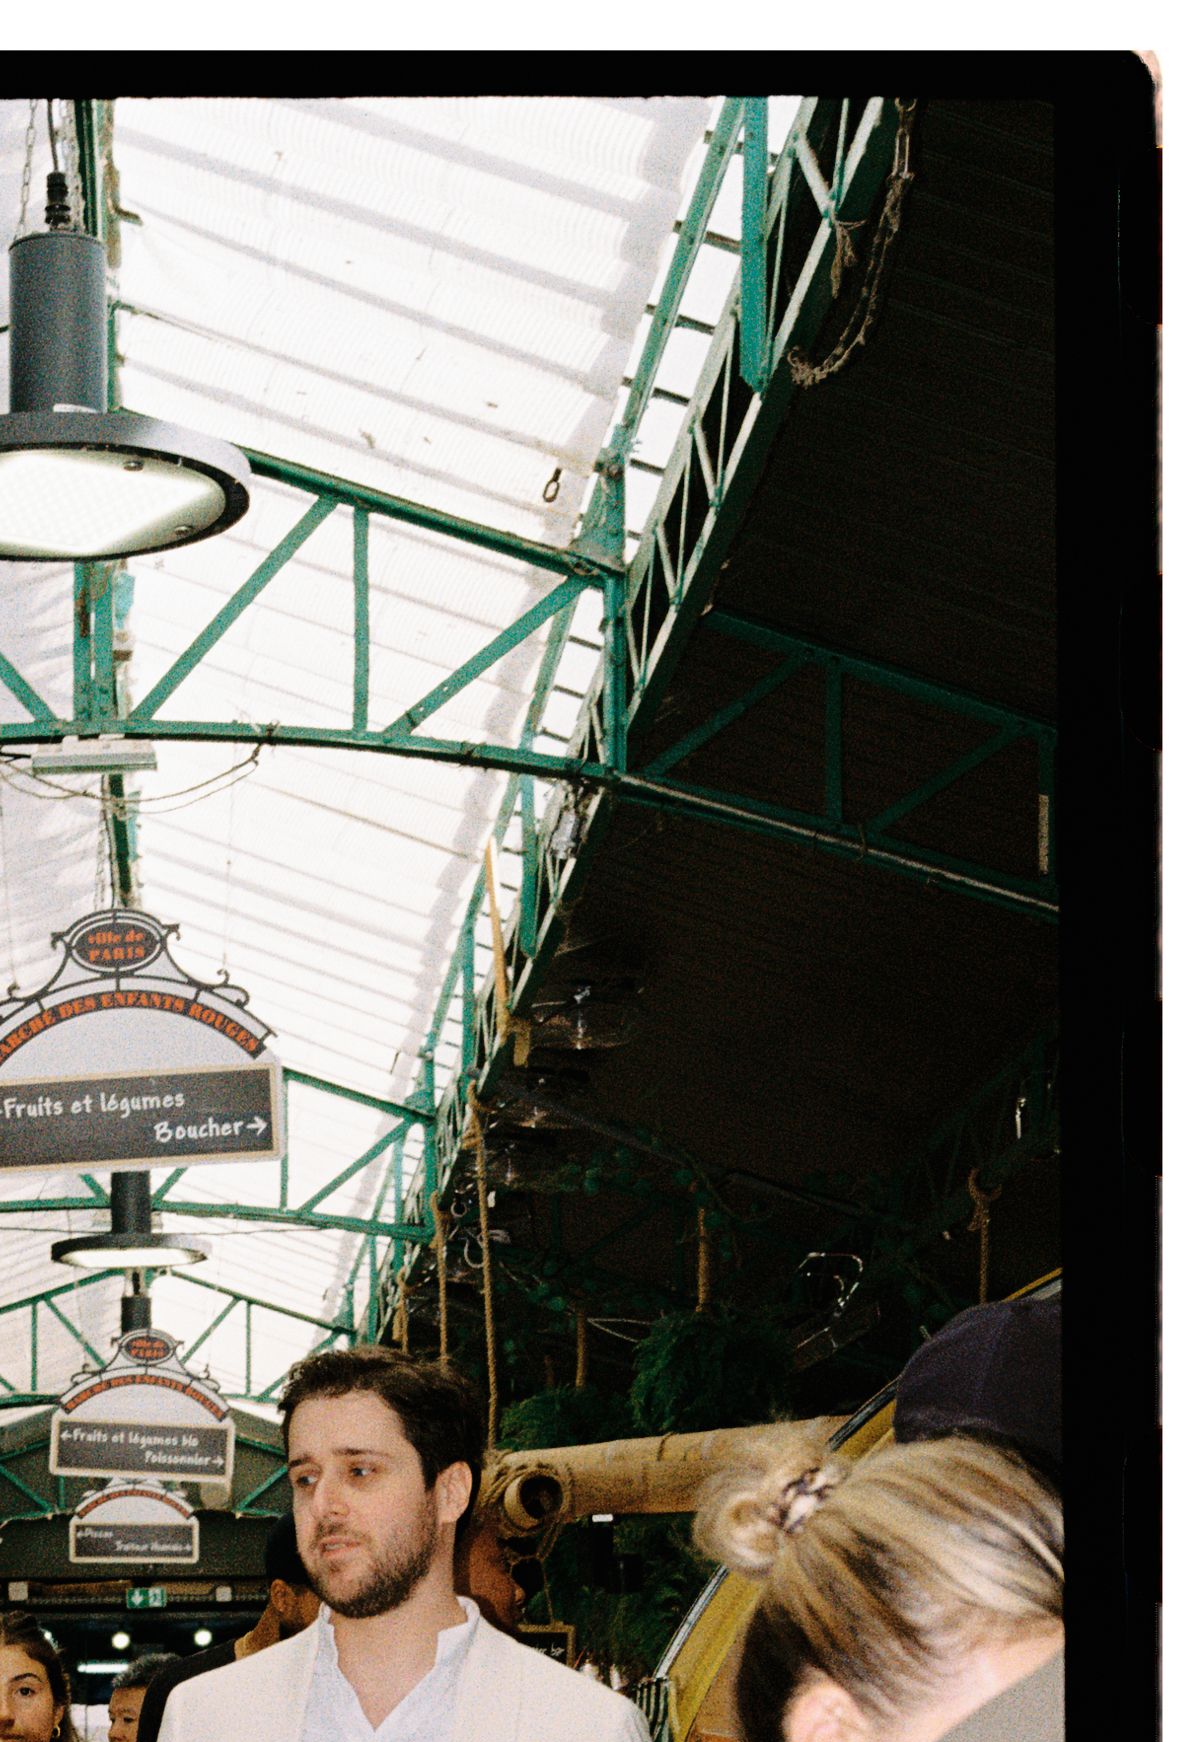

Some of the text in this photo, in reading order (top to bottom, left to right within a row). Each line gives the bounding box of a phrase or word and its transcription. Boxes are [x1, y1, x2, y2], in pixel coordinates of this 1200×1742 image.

[125, 930, 144, 943] de
[89, 947, 145, 962] PARIS
[59, 993, 97, 1017] DES
[101, 990, 184, 1014] ENFANTS
[188, 1001, 260, 1053] ROUGES
[3, 1092, 185, 1119] Fruits et légumes
[154, 1117, 243, 1143] Boucher
[73, 1428, 199, 1448] Fruits et légumes bio
[145, 1451, 211, 1466] Poissonnier
